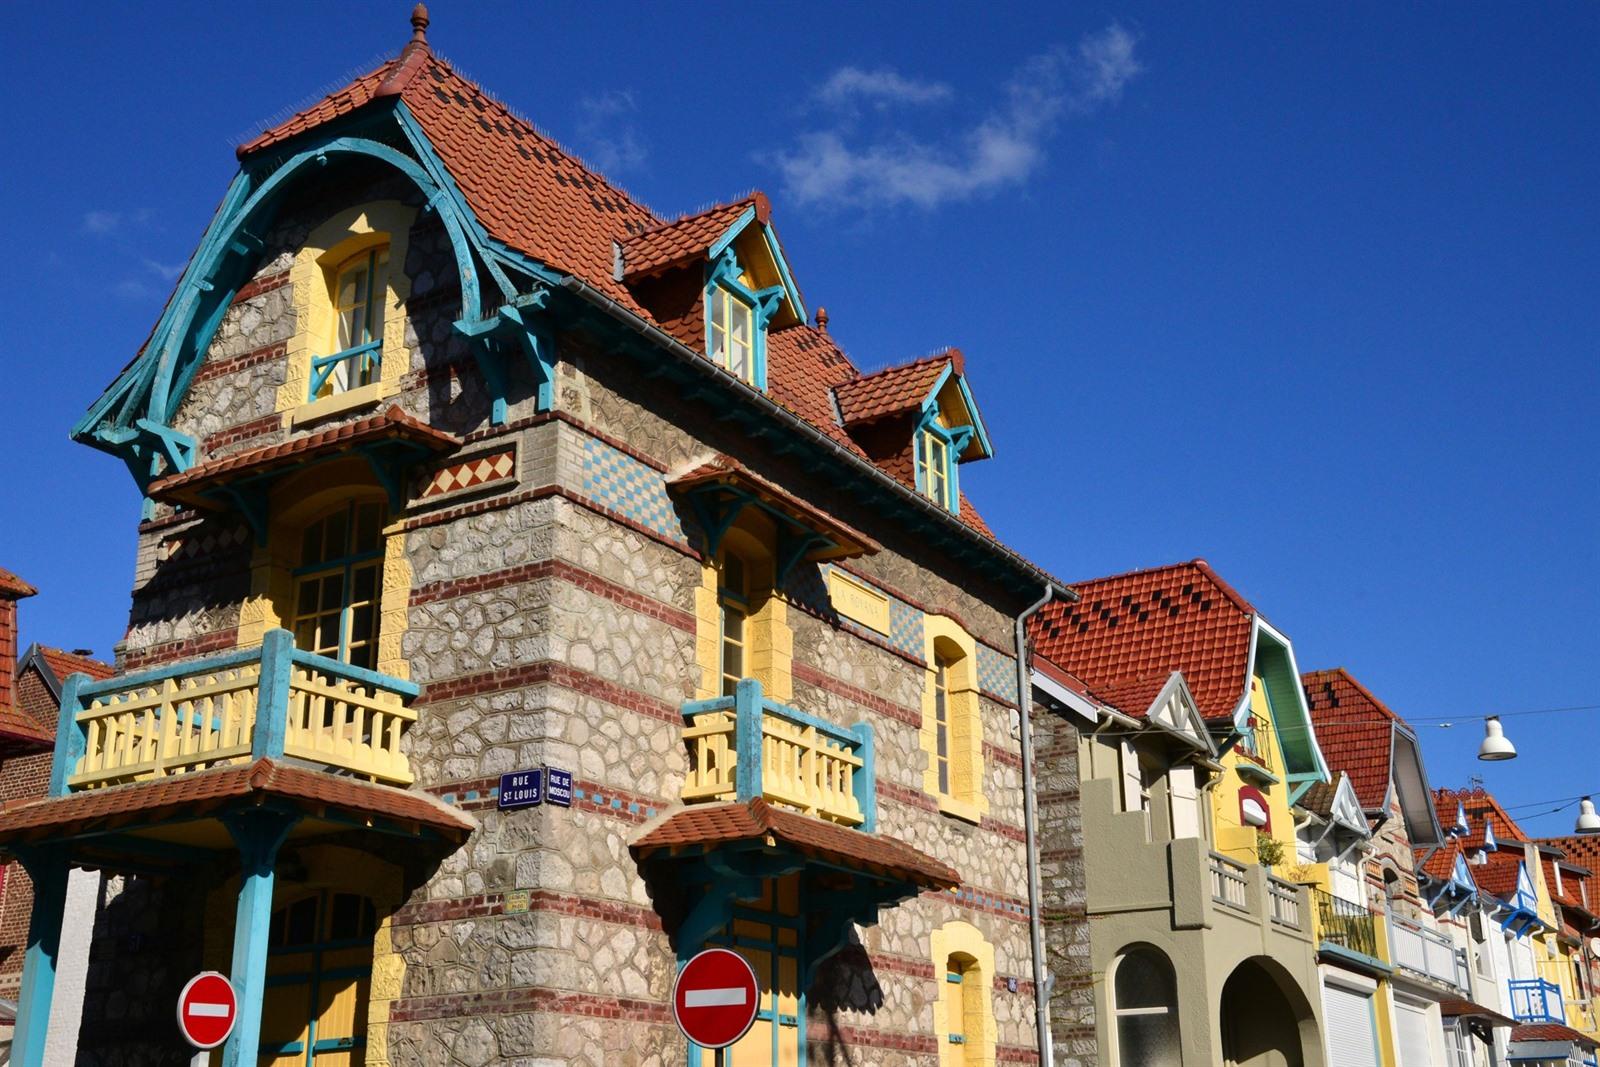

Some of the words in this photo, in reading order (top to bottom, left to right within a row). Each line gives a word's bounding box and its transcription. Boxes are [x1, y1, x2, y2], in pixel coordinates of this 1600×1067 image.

[512, 775, 529, 787] RUE
[550, 774, 561, 785] RUE
[562, 777, 570, 787] DE
[514, 788, 537, 800] LOUIS
[549, 785, 570, 799] MOSCOU
